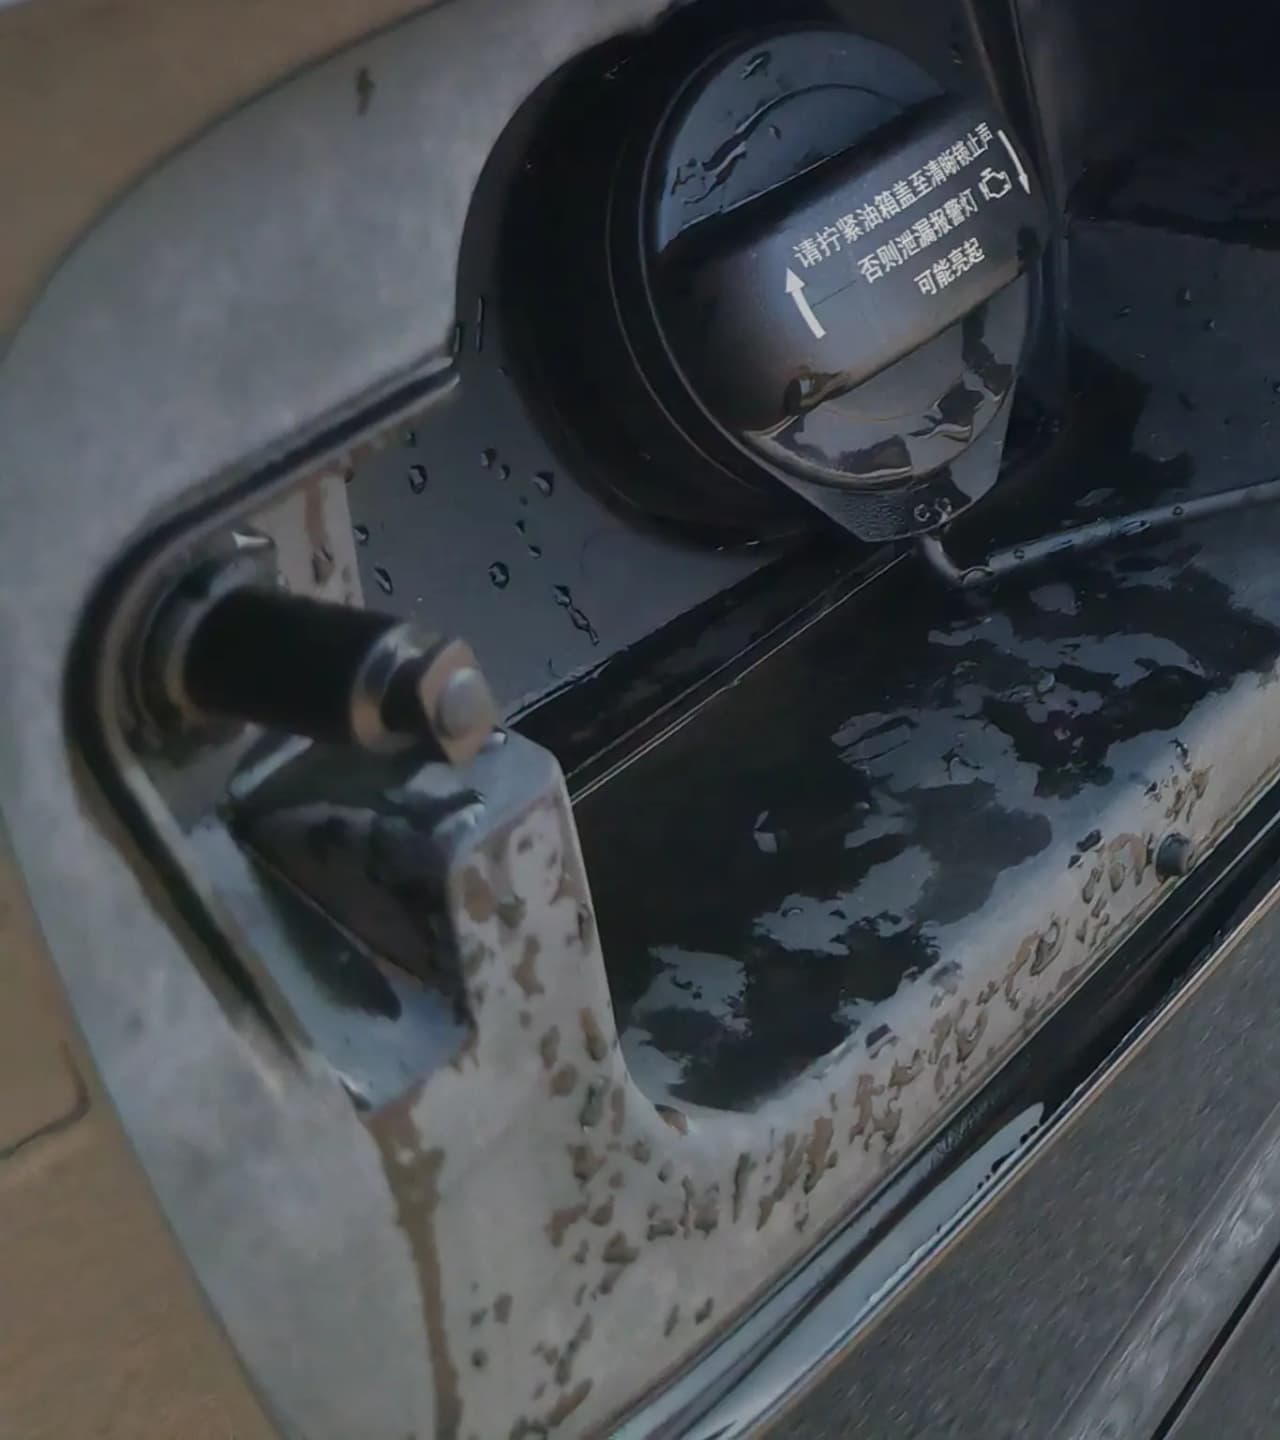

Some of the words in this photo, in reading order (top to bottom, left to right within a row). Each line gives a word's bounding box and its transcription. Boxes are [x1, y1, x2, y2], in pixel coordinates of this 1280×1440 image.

[857, 188, 978, 284] 否则泄漏报警灯
[914, 237, 985, 297] 可能亮起
